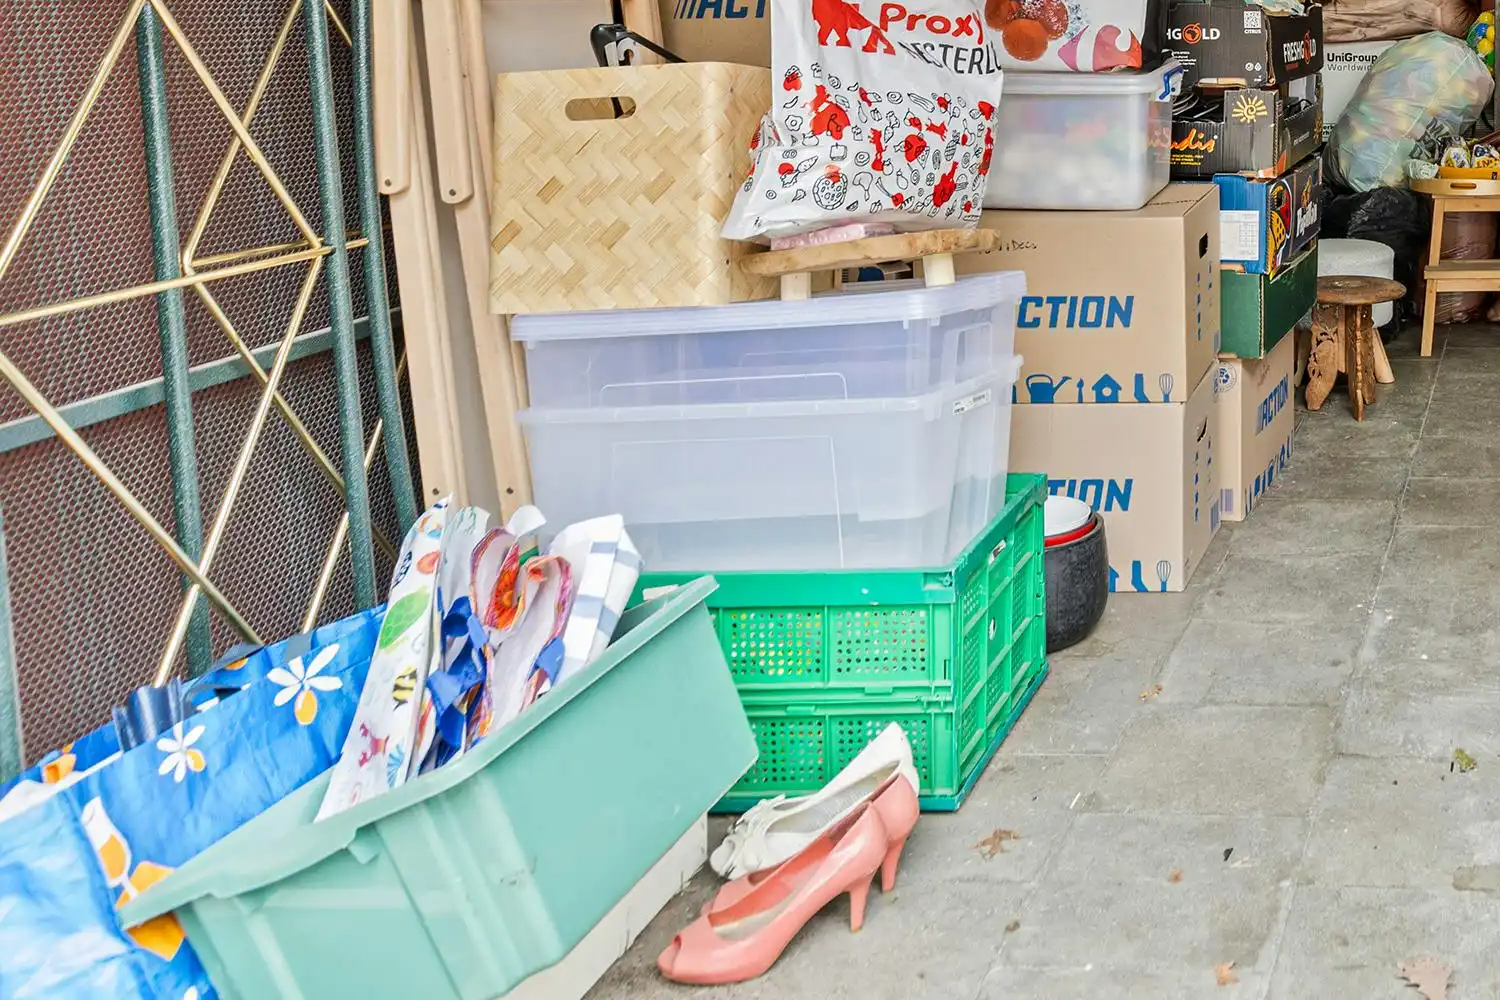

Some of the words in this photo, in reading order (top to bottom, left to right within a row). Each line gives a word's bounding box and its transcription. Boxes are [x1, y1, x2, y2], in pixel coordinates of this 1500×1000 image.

[880, 3, 983, 45] Proxy
[1327, 53, 1378, 64] UniGroup
[1017, 296, 1134, 328] CTION
[1261, 373, 1289, 430] ACTION
[1047, 478, 1134, 512] TION
